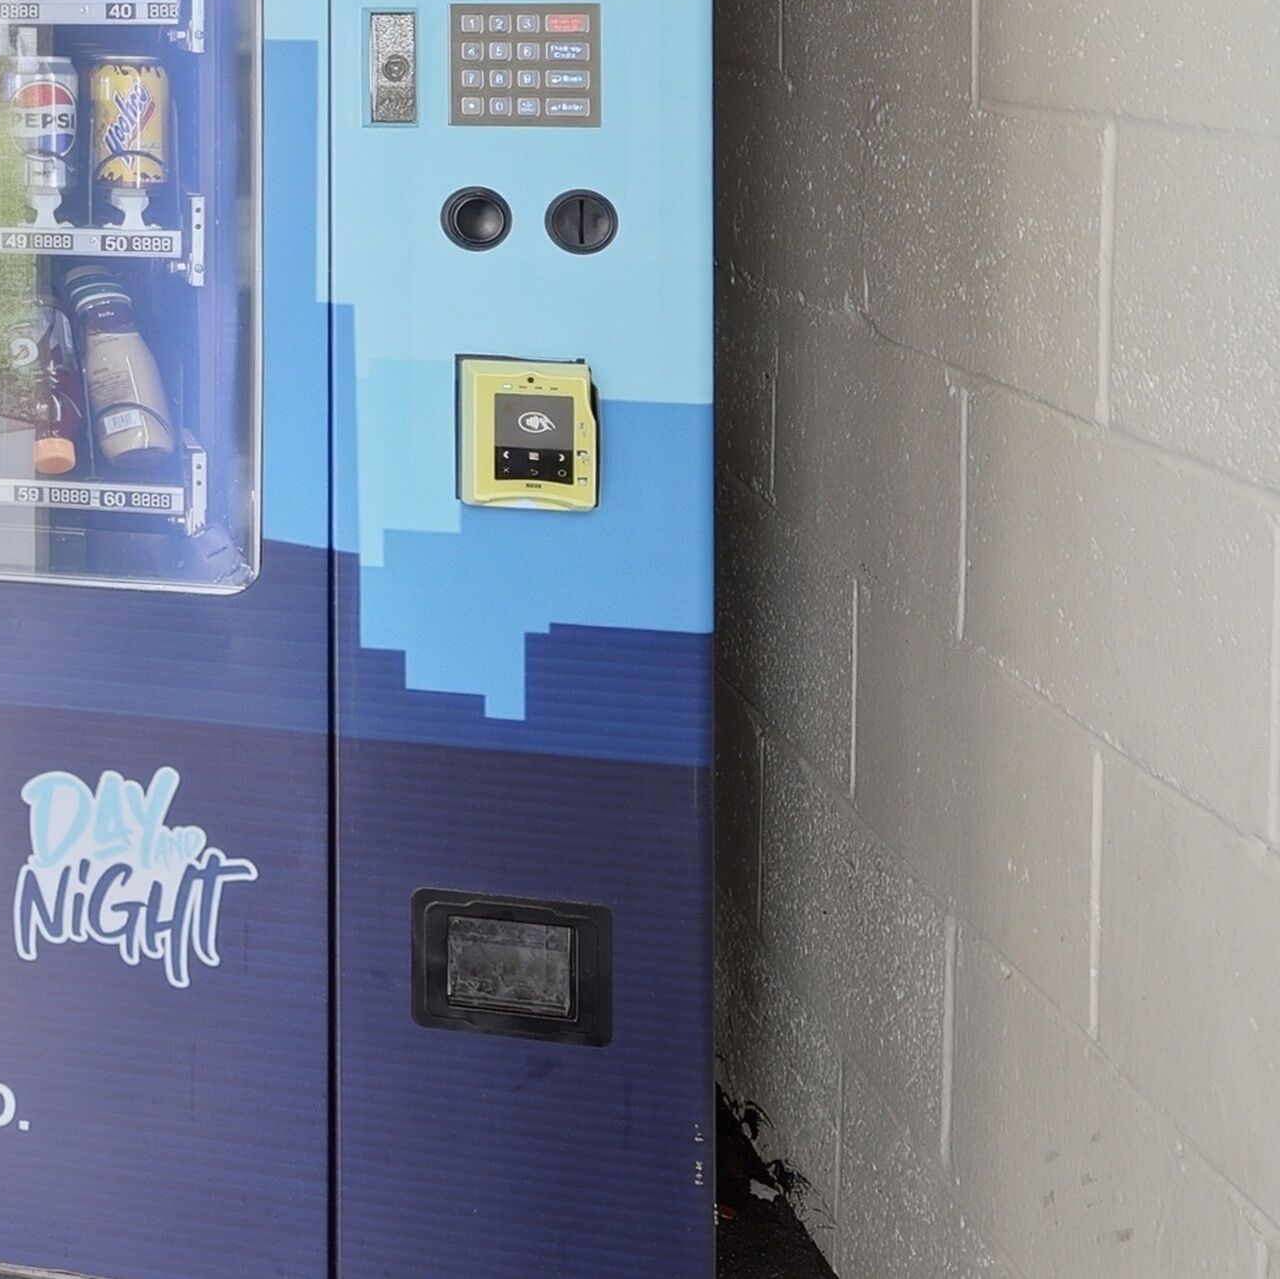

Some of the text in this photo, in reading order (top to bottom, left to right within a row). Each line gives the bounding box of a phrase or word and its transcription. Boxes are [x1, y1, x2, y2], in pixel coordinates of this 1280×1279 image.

[109, 5, 131, 18] 40
[11, 112, 75, 129] PEPSI
[6, 234, 27, 247] 49
[105, 237, 127, 251] 50
[103, 492, 126, 507] 60
[21, 766, 180, 870] DAY
[156, 826, 204, 865] AND
